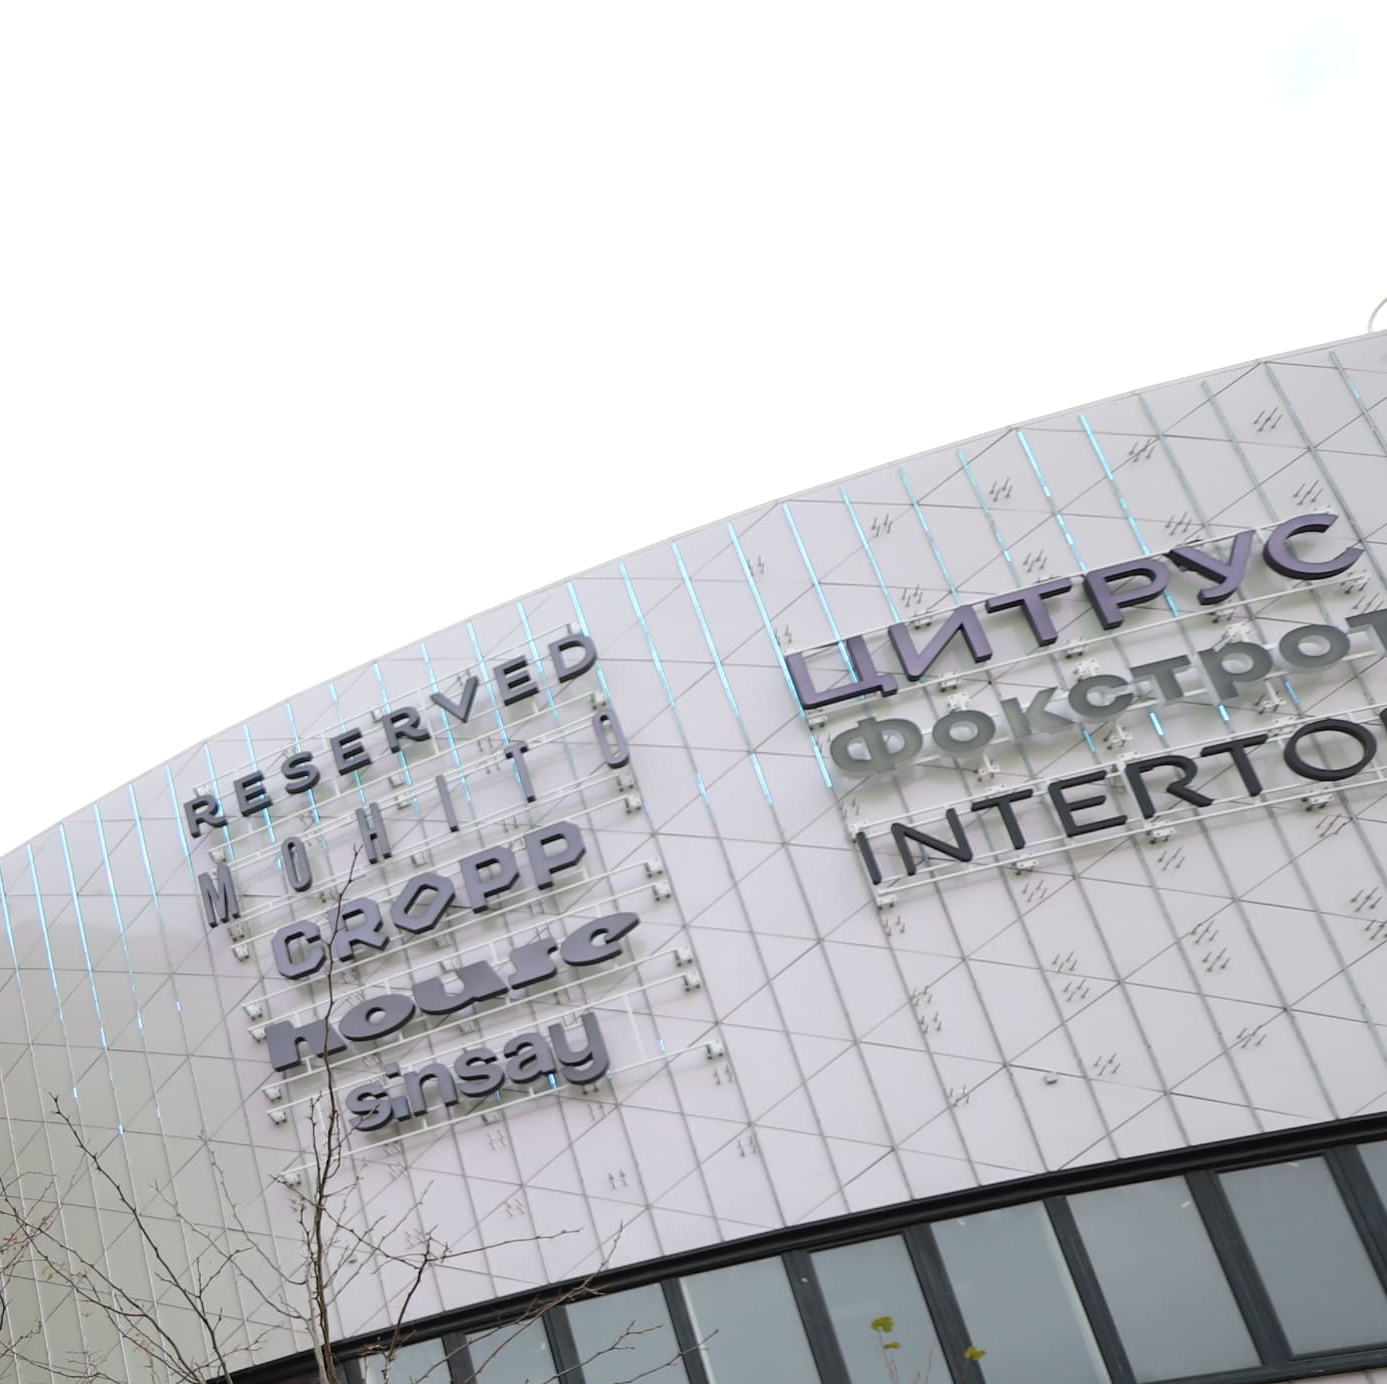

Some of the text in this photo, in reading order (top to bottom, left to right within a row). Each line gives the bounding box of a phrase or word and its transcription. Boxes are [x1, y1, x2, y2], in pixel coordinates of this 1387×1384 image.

[785, 513, 1364, 709] ЦИТРУС
[184, 632, 598, 839] RESERVED
[197, 707, 630, 928] MOHITO
[854, 708, 1387, 886] INTERTO
[271, 820, 586, 980] CROPP
[346, 1011, 611, 1132] sinsay
